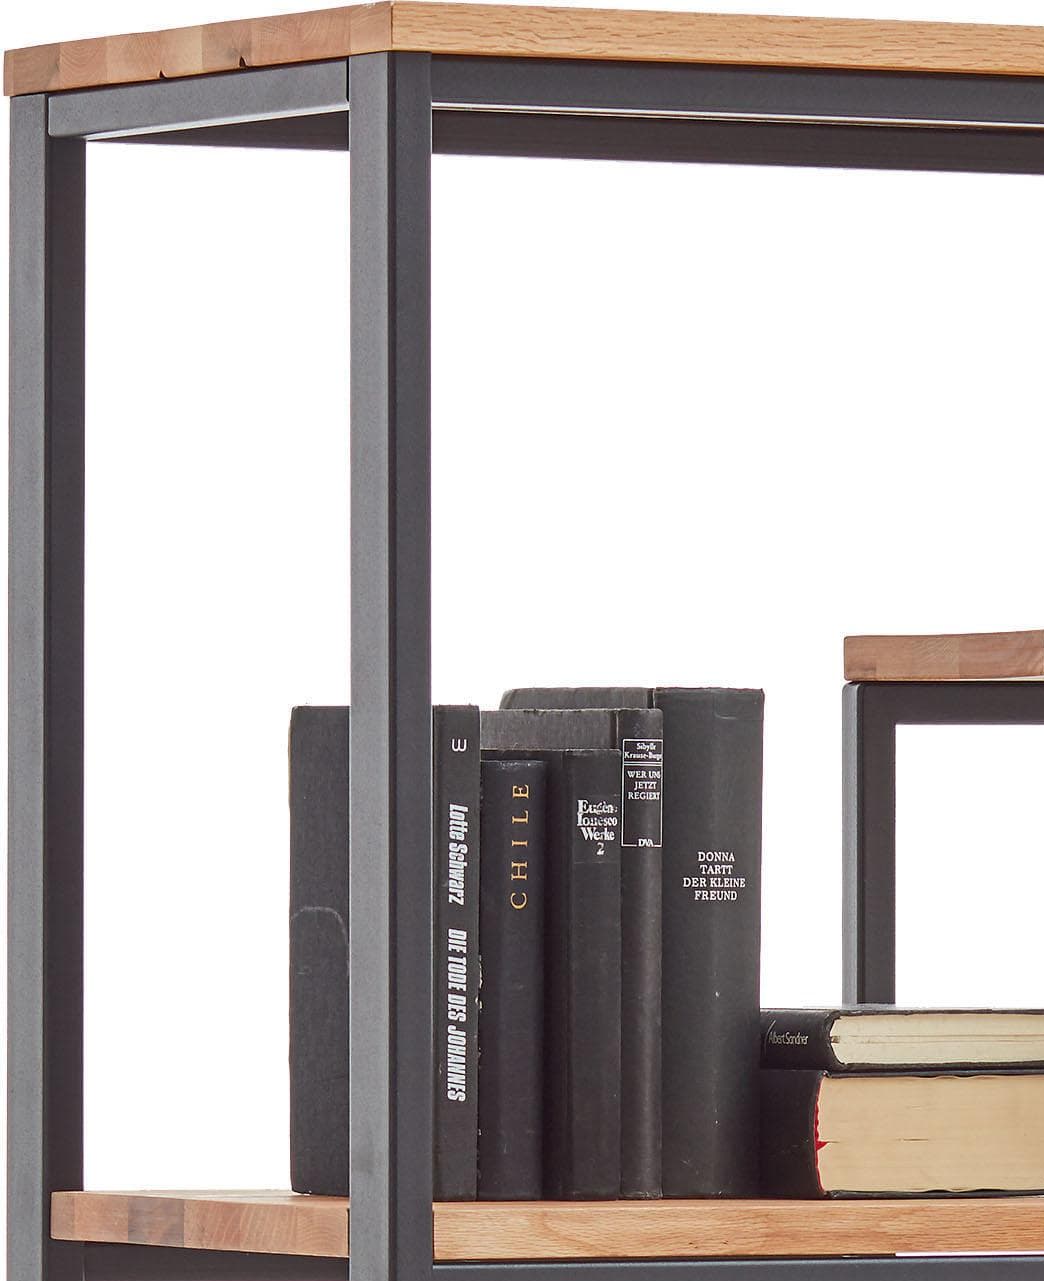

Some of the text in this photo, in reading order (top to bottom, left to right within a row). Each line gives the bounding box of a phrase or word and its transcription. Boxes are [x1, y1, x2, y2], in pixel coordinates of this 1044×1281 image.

[627, 770, 647, 779] WER
[634, 781, 657, 790] JETZT
[628, 791, 660, 800] REGIERT
[581, 827, 615, 841] Werke
[510, 784, 529, 910] CHILE
[638, 838, 654, 847] DVA
[597, 842, 605, 855] 2
[448, 803, 469, 906] Lotte Schwarz
[697, 851, 735, 862] DONNA
[699, 864, 733, 875] TARTT
[683, 877, 746, 888] DER KLEINE
[694, 890, 738, 901] FREUND
[447, 928, 467, 1102] DIE TODE DES JOHANNES
